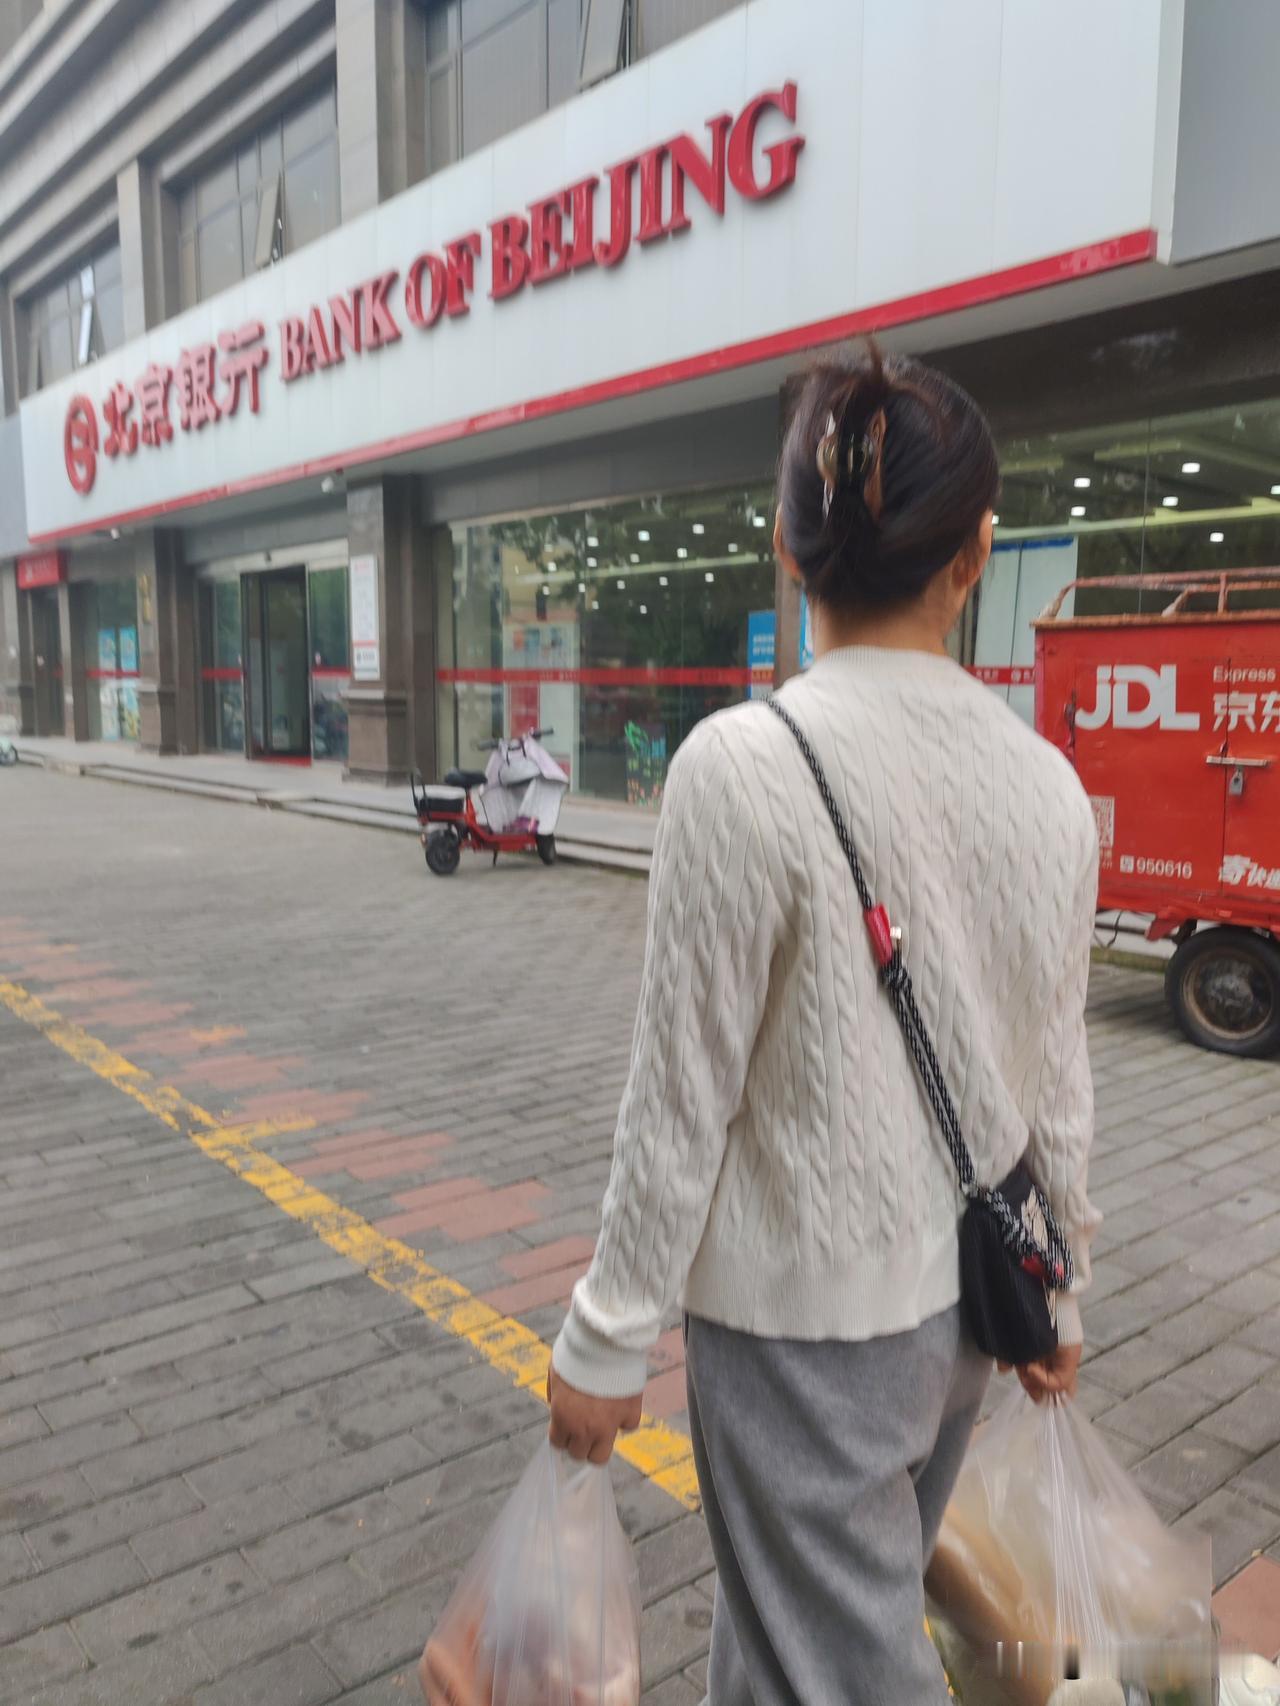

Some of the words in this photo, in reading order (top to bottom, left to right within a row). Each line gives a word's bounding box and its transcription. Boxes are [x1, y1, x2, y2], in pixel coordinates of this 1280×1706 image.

[280, 270, 402, 383] BANK
[405, 231, 482, 330] OF
[487, 79, 805, 302] BEIJING
[1074, 664, 1200, 731] JDL
[1212, 665, 1277, 685] Express
[1136, 857, 1192, 880] 950616
